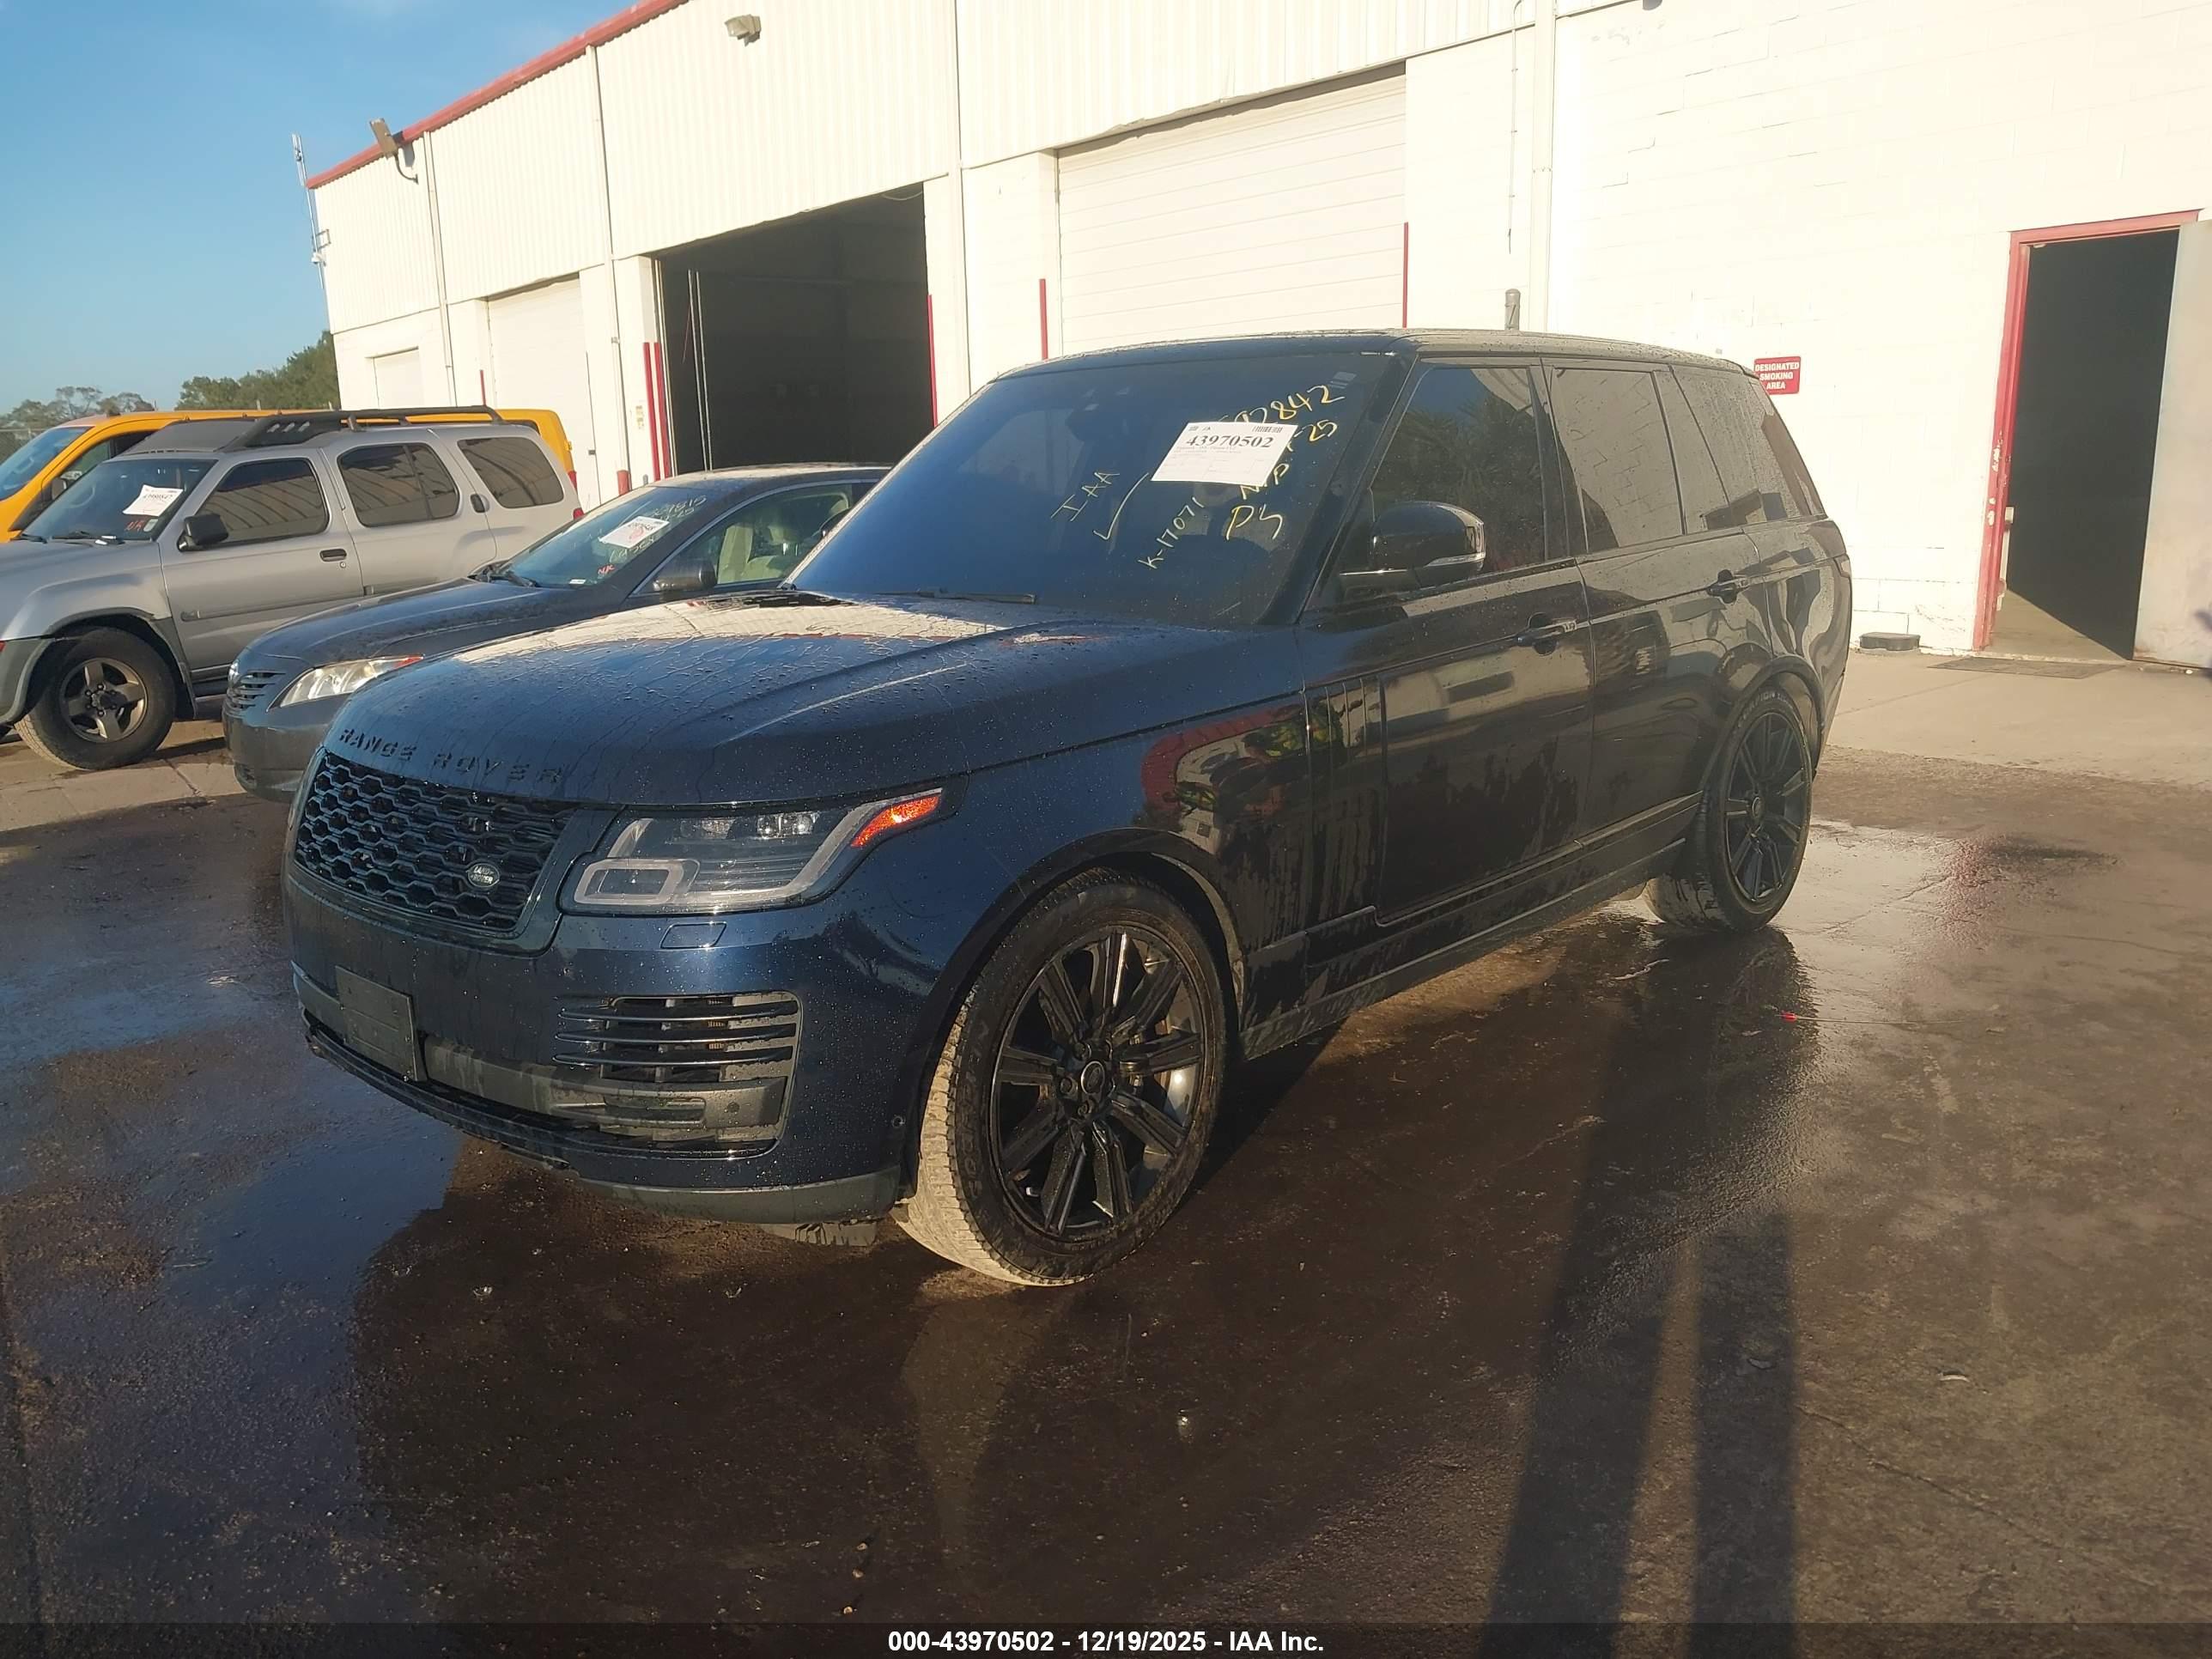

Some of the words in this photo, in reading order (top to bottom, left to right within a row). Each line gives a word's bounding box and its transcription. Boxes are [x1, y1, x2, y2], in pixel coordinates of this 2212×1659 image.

[1755, 362, 1800, 371] DESIGNATED
[1759, 372, 1794, 380] SMOKING
[1765, 381, 1786, 390] AREA
[1186, 434, 1275, 448] 43970502
[339, 727, 417, 763] RANGE
[433, 751, 563, 785] ROVER
